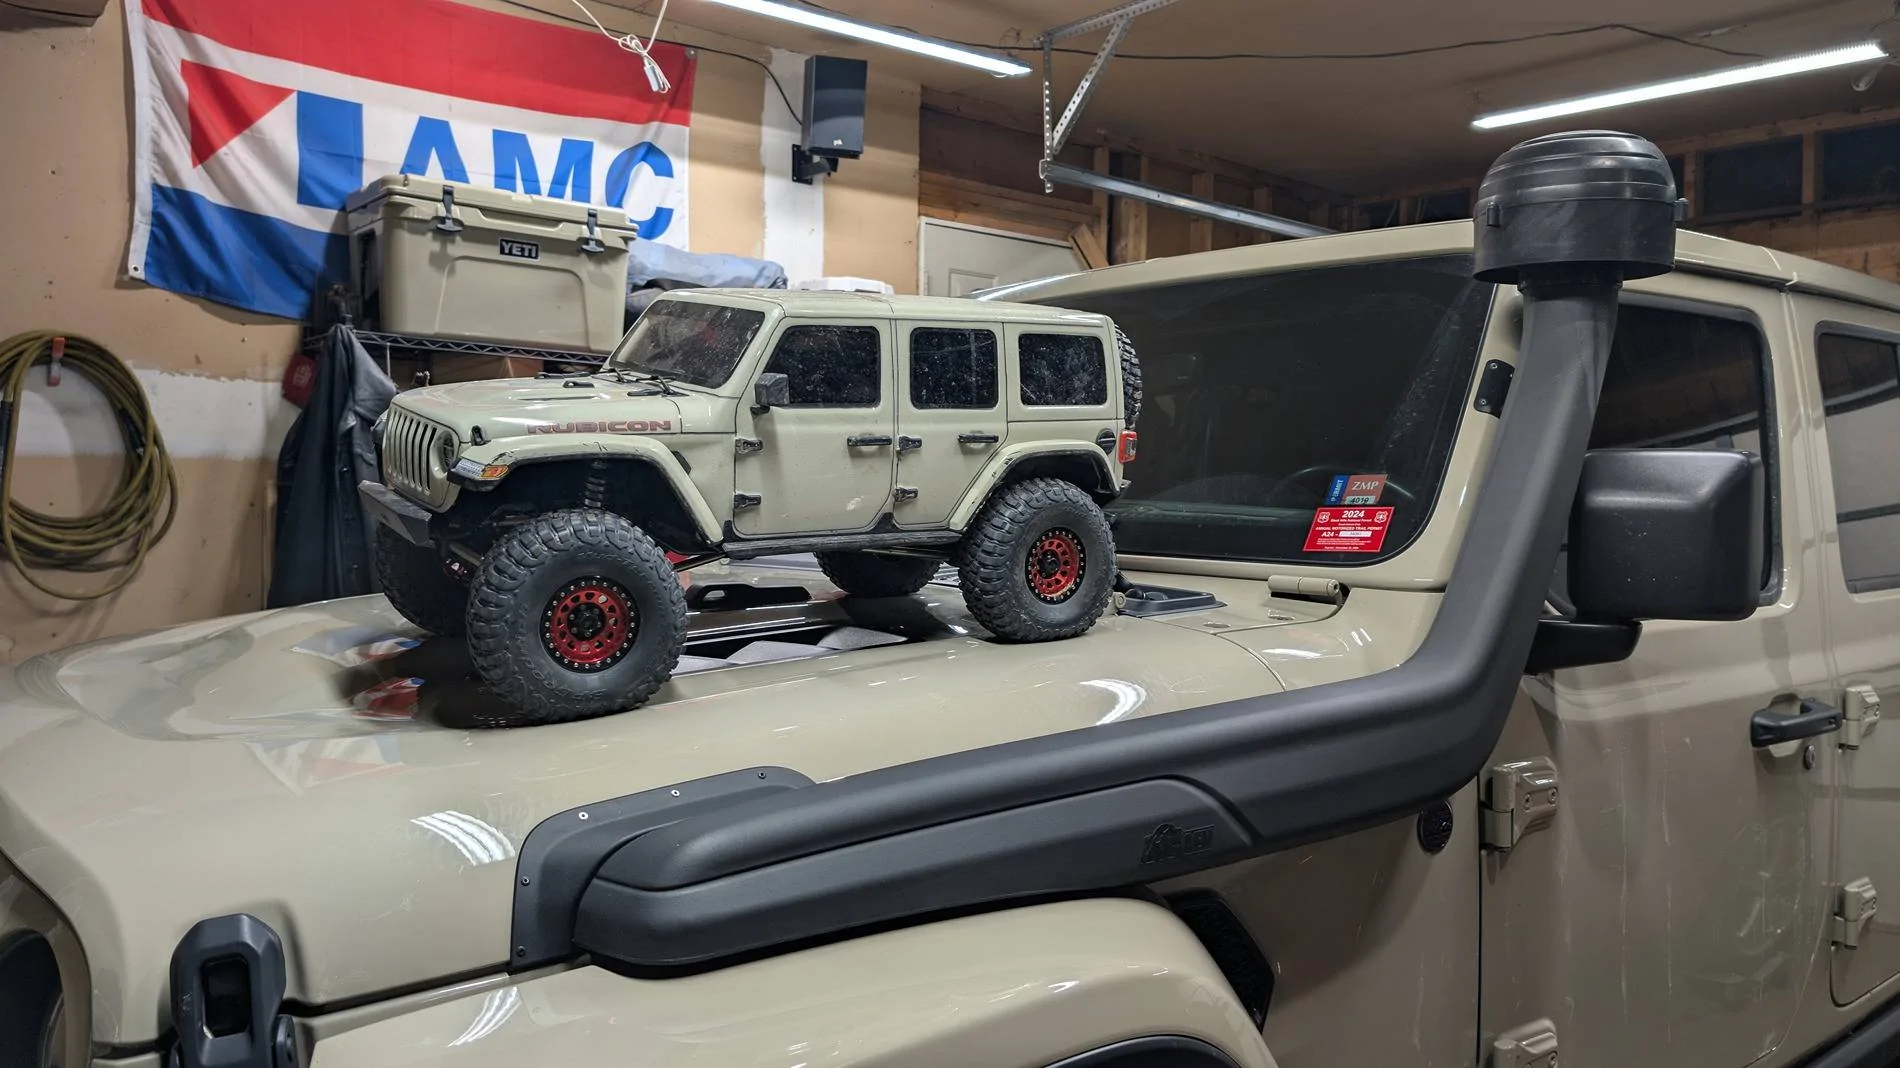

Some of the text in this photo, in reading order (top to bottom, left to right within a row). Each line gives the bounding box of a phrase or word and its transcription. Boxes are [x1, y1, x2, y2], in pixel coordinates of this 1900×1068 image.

[400, 115, 674, 241] AMC
[502, 241, 537, 258] YETI
[527, 420, 671, 434] RUBICON
[1352, 481, 1379, 490] ZMP
[1342, 510, 1365, 518] 2024
